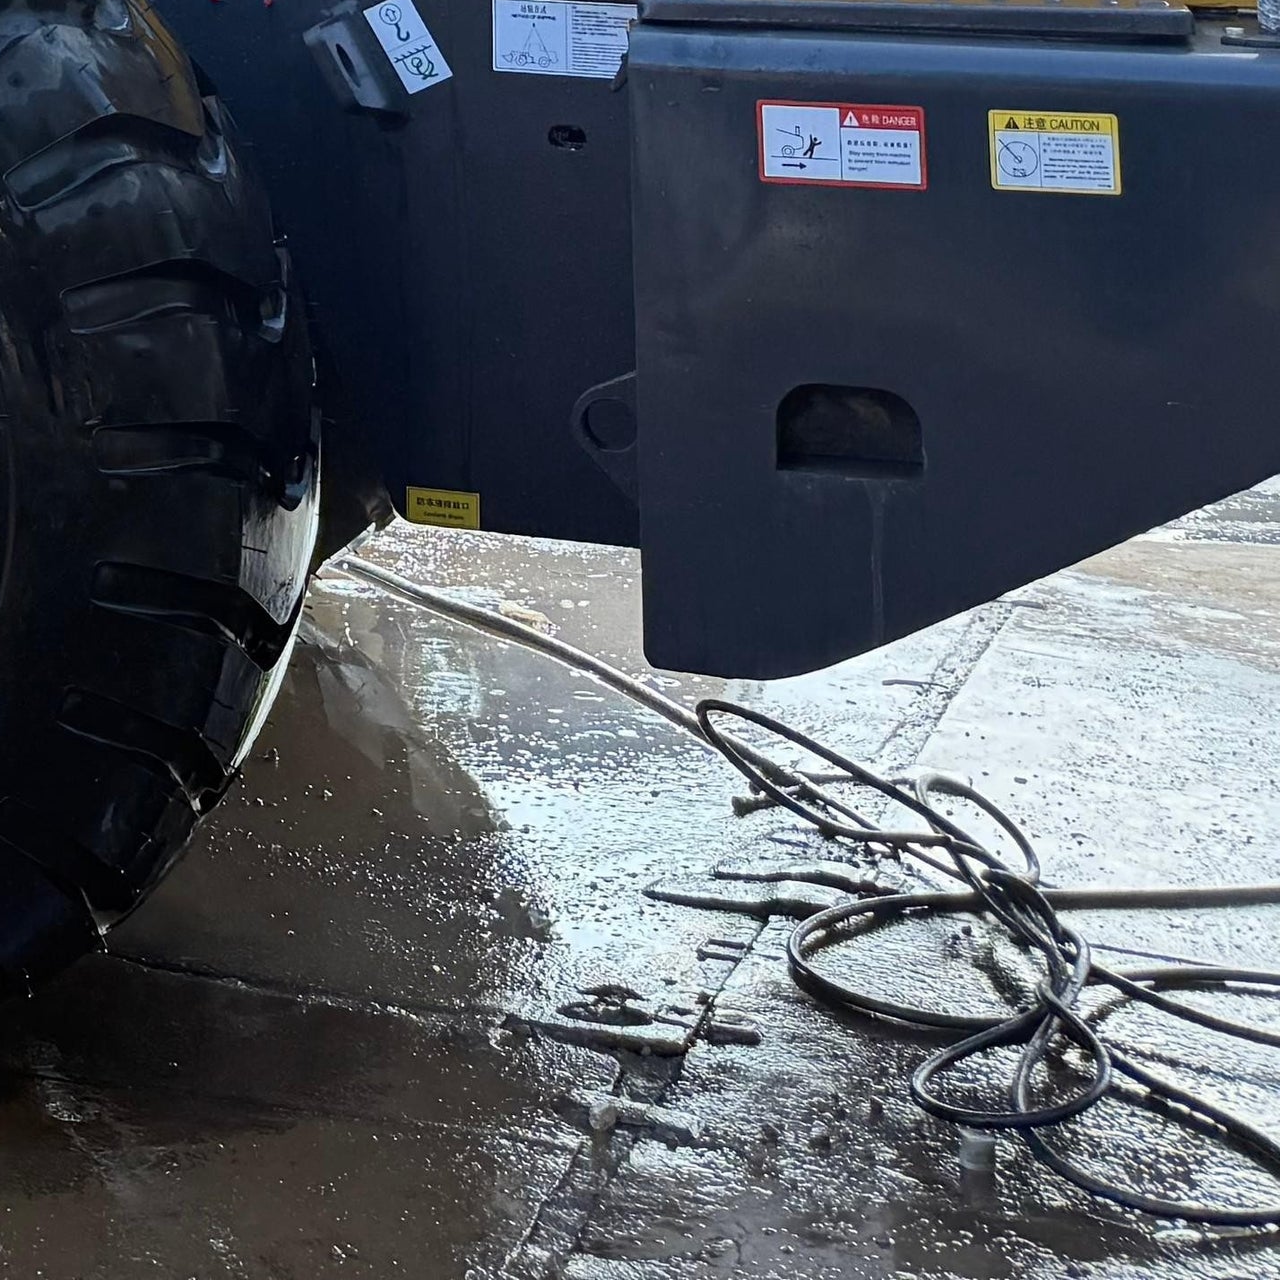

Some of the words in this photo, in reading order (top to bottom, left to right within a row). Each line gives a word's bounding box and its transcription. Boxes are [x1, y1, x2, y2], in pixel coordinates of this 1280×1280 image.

[882, 115, 916, 126] DANGER
[1023, 117, 1047, 130] 注意
[1049, 119, 1100, 131] CAUTION
